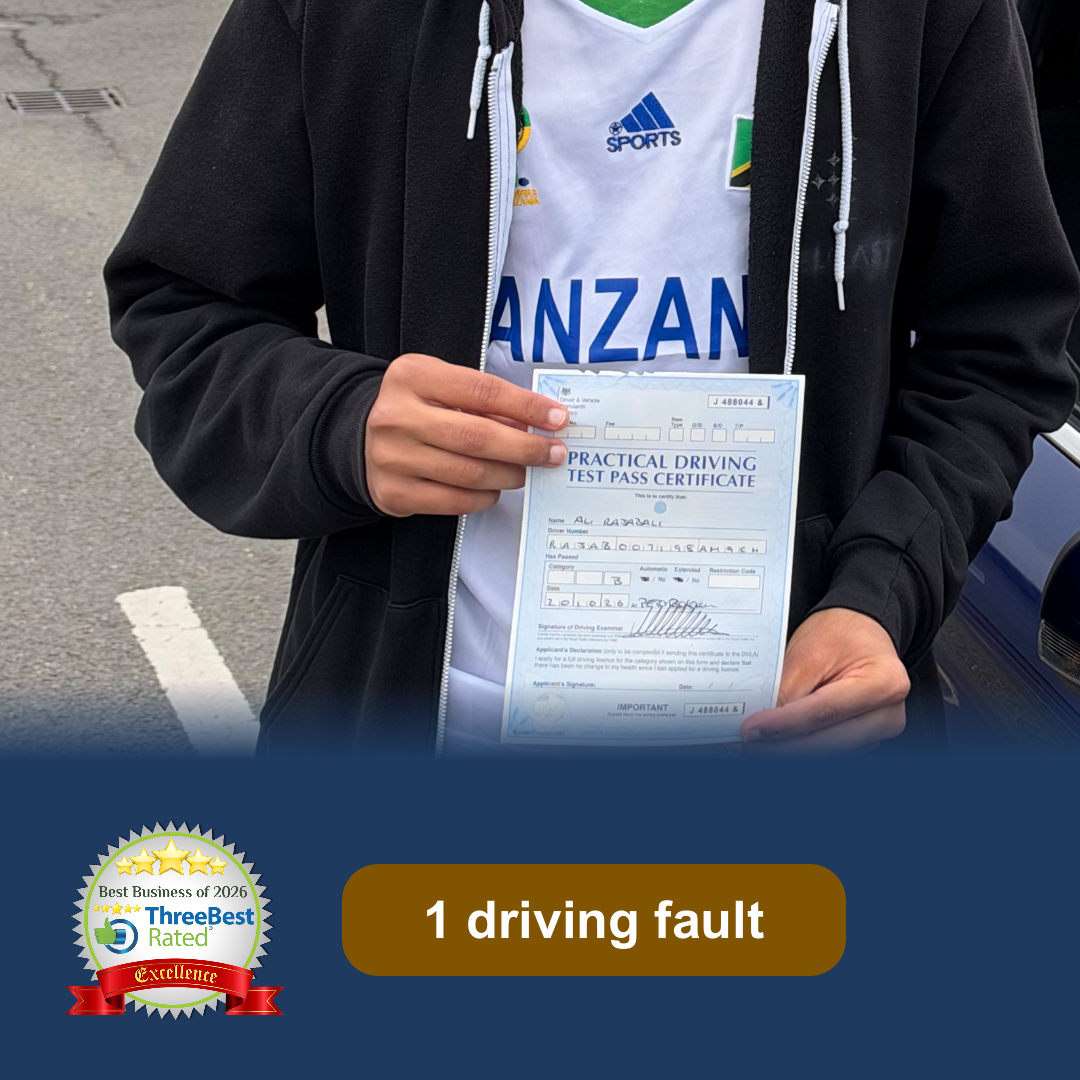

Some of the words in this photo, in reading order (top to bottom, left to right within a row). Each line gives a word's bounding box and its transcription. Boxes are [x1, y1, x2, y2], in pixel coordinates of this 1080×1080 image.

[606, 130, 682, 153] SPORTS
[713, 398, 718, 406] J
[722, 398, 754, 406] 488044
[568, 451, 668, 469] PRACTICAL
[675, 455, 757, 472] DRIVING
[567, 469, 605, 482] TEST
[610, 470, 648, 484] PASS
[654, 472, 756, 488] CERTIFICATE
[617, 703, 669, 712] IMPORTANT
[690, 706, 694, 714] J
[698, 706, 730, 714] 488044
